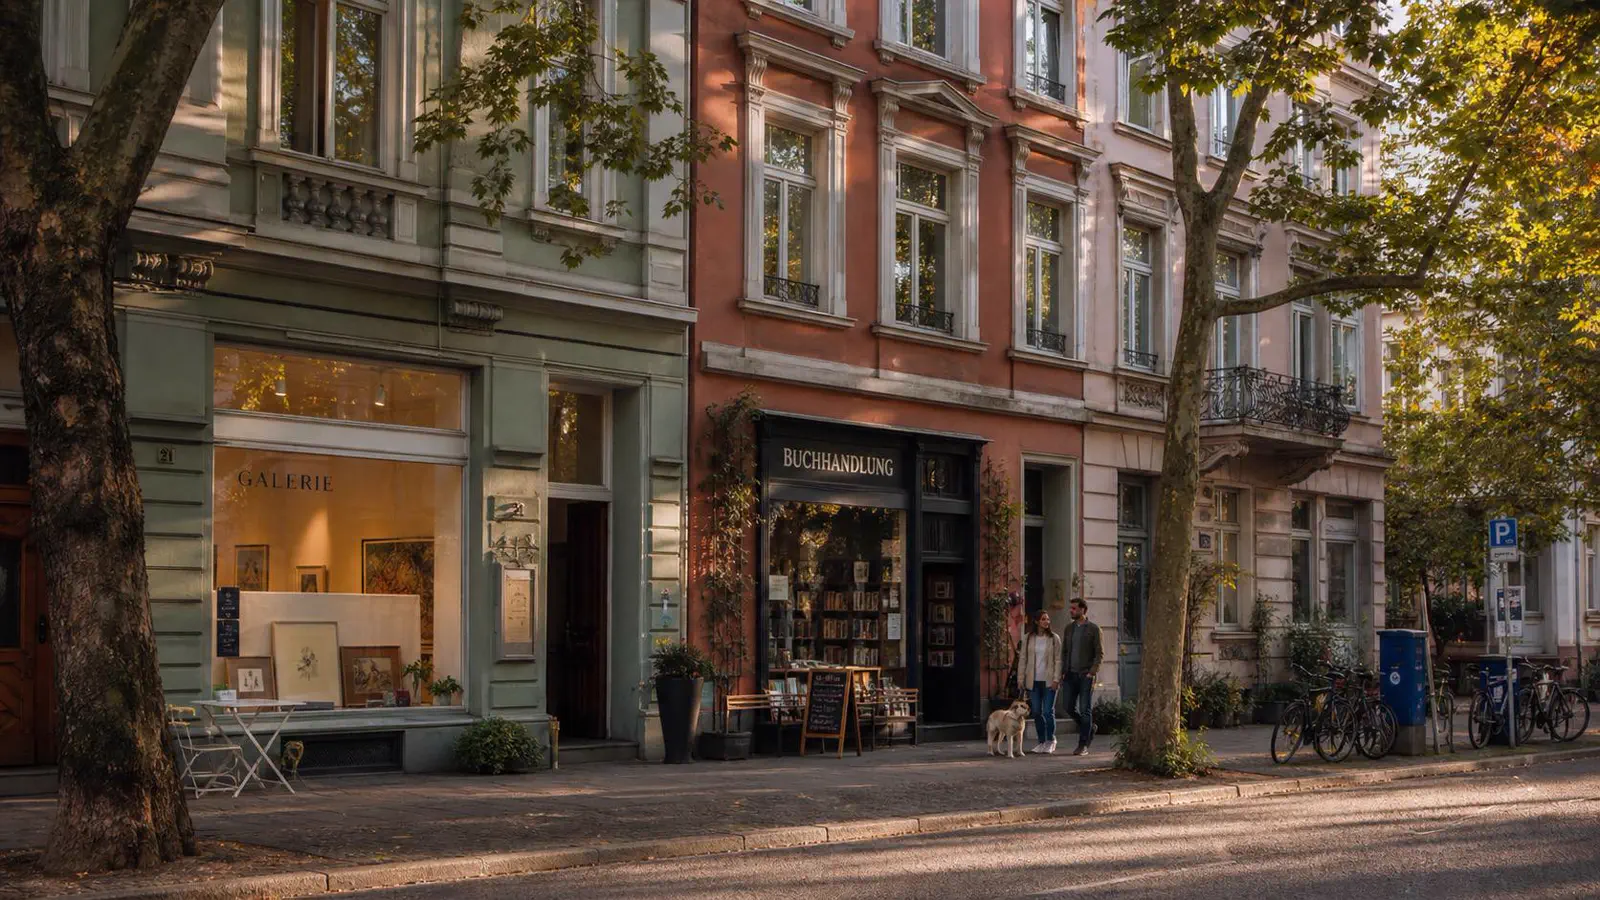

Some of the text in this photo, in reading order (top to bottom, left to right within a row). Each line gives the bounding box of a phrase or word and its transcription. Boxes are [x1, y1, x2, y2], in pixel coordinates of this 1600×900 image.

[784, 448, 894, 476] BUCHHANDLUNG
[238, 470, 333, 492] GALERIE
[1495, 522, 1510, 544] P
